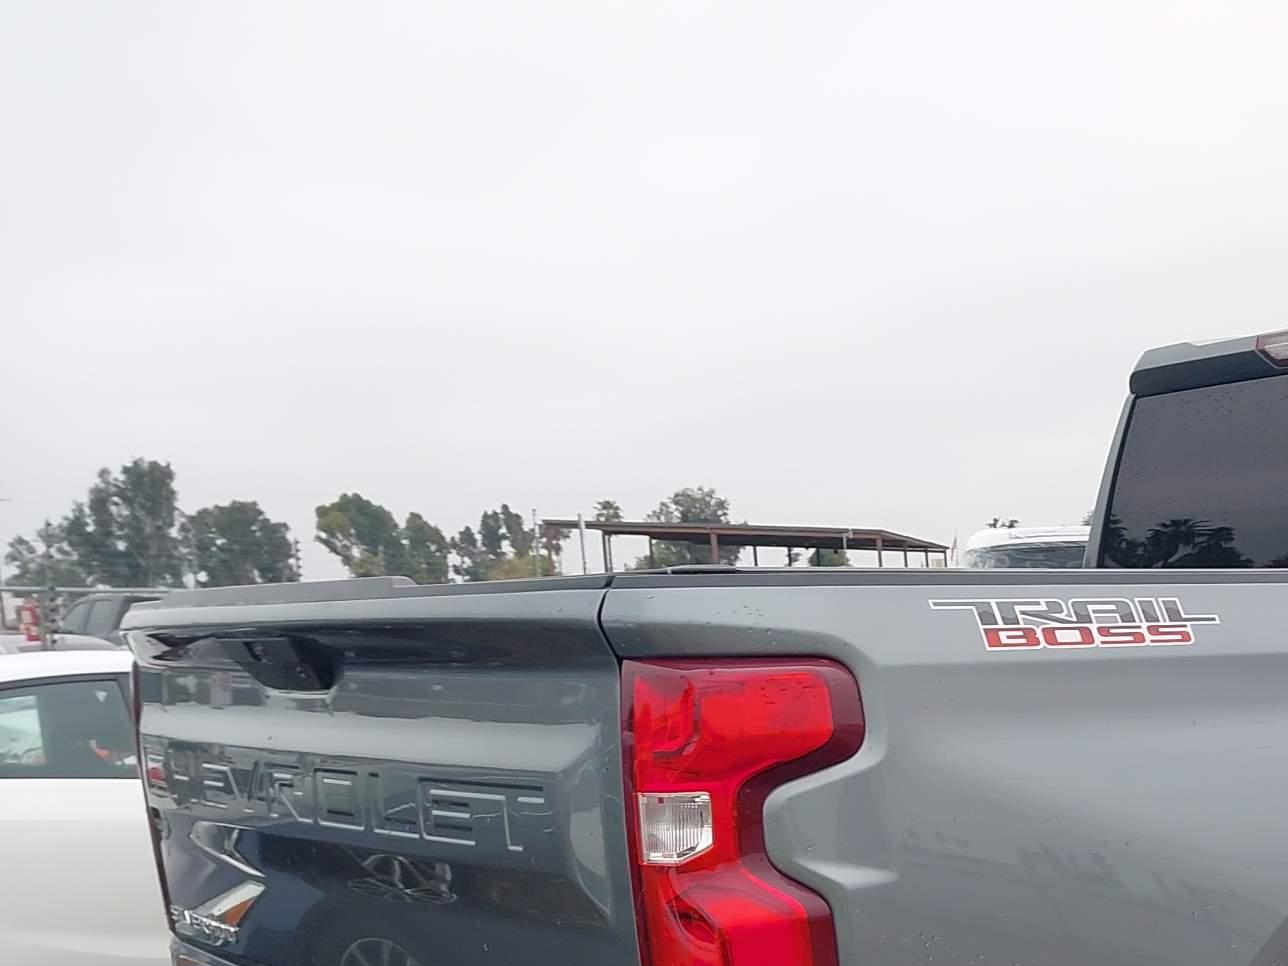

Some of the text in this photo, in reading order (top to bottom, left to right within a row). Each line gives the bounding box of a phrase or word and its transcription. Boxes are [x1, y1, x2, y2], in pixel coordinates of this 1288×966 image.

[928, 598, 1221, 625] TRAIL
[983, 624, 1196, 651] BOSS
[146, 749, 545, 852] HEVROLET
